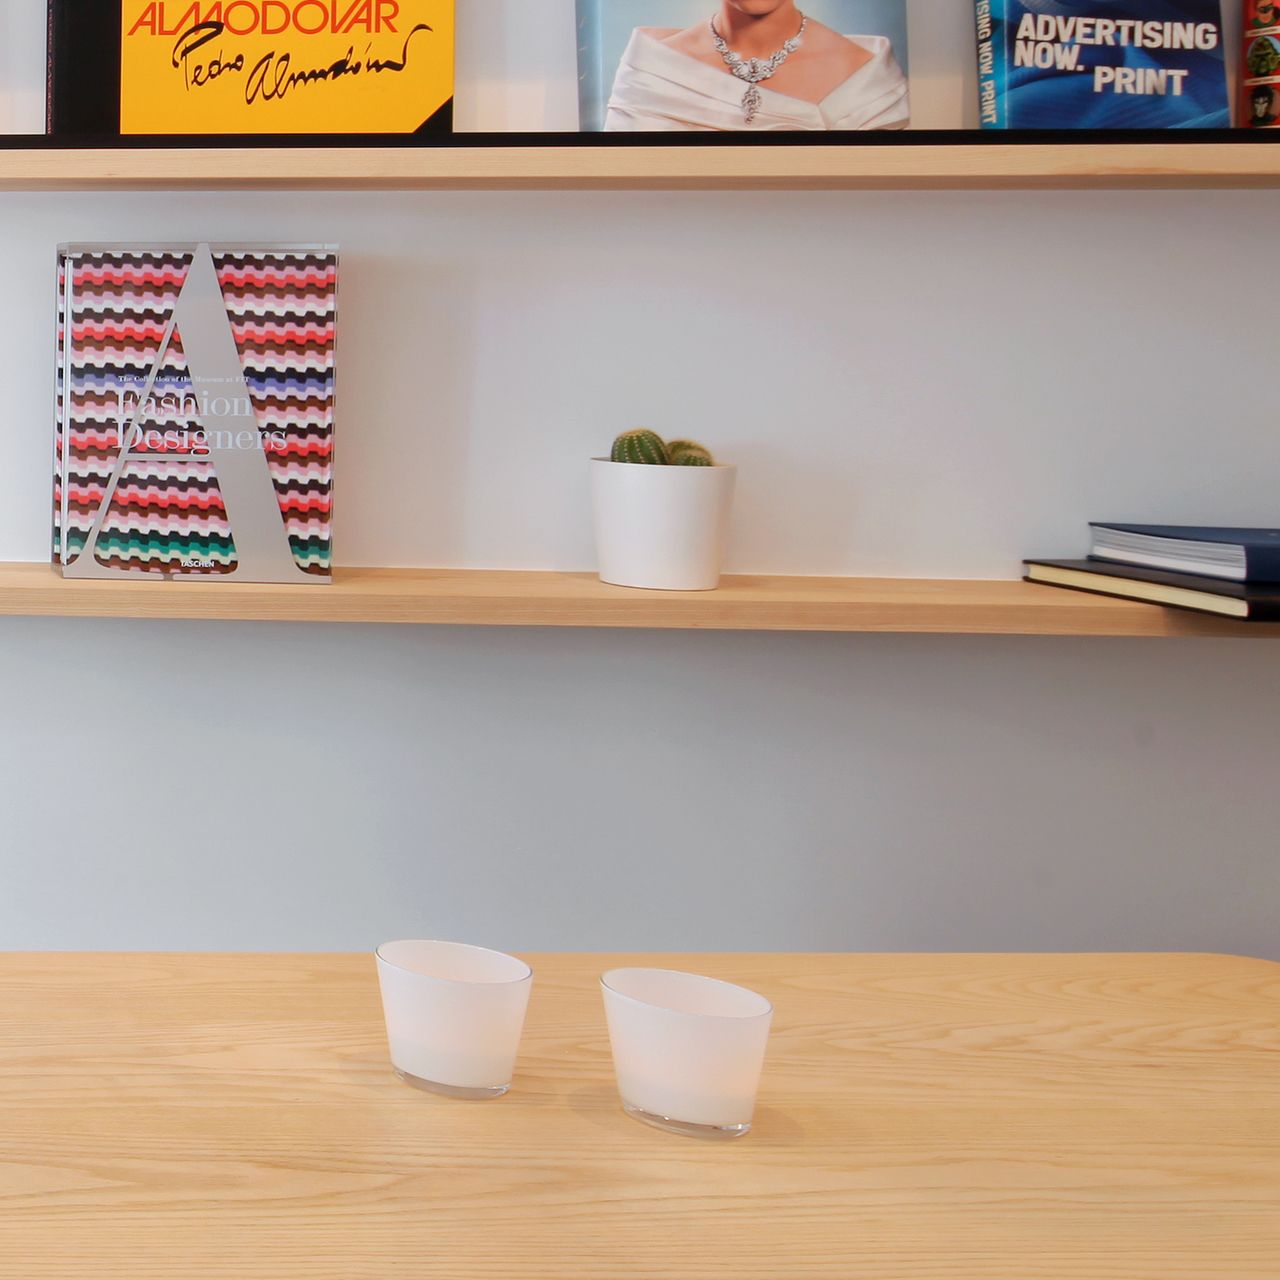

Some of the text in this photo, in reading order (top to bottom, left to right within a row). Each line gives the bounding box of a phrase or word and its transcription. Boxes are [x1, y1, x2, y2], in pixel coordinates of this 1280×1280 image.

[1016, 13, 1218, 50] ADVERTISING
[1014, 40, 1084, 71] NOW.
[1093, 66, 1188, 96] PRINT
[981, 79, 997, 124] PRINT
[118, 388, 252, 417] Fashion
[112, 420, 288, 457] Designers
[180, 560, 215, 568] TASCHEN
